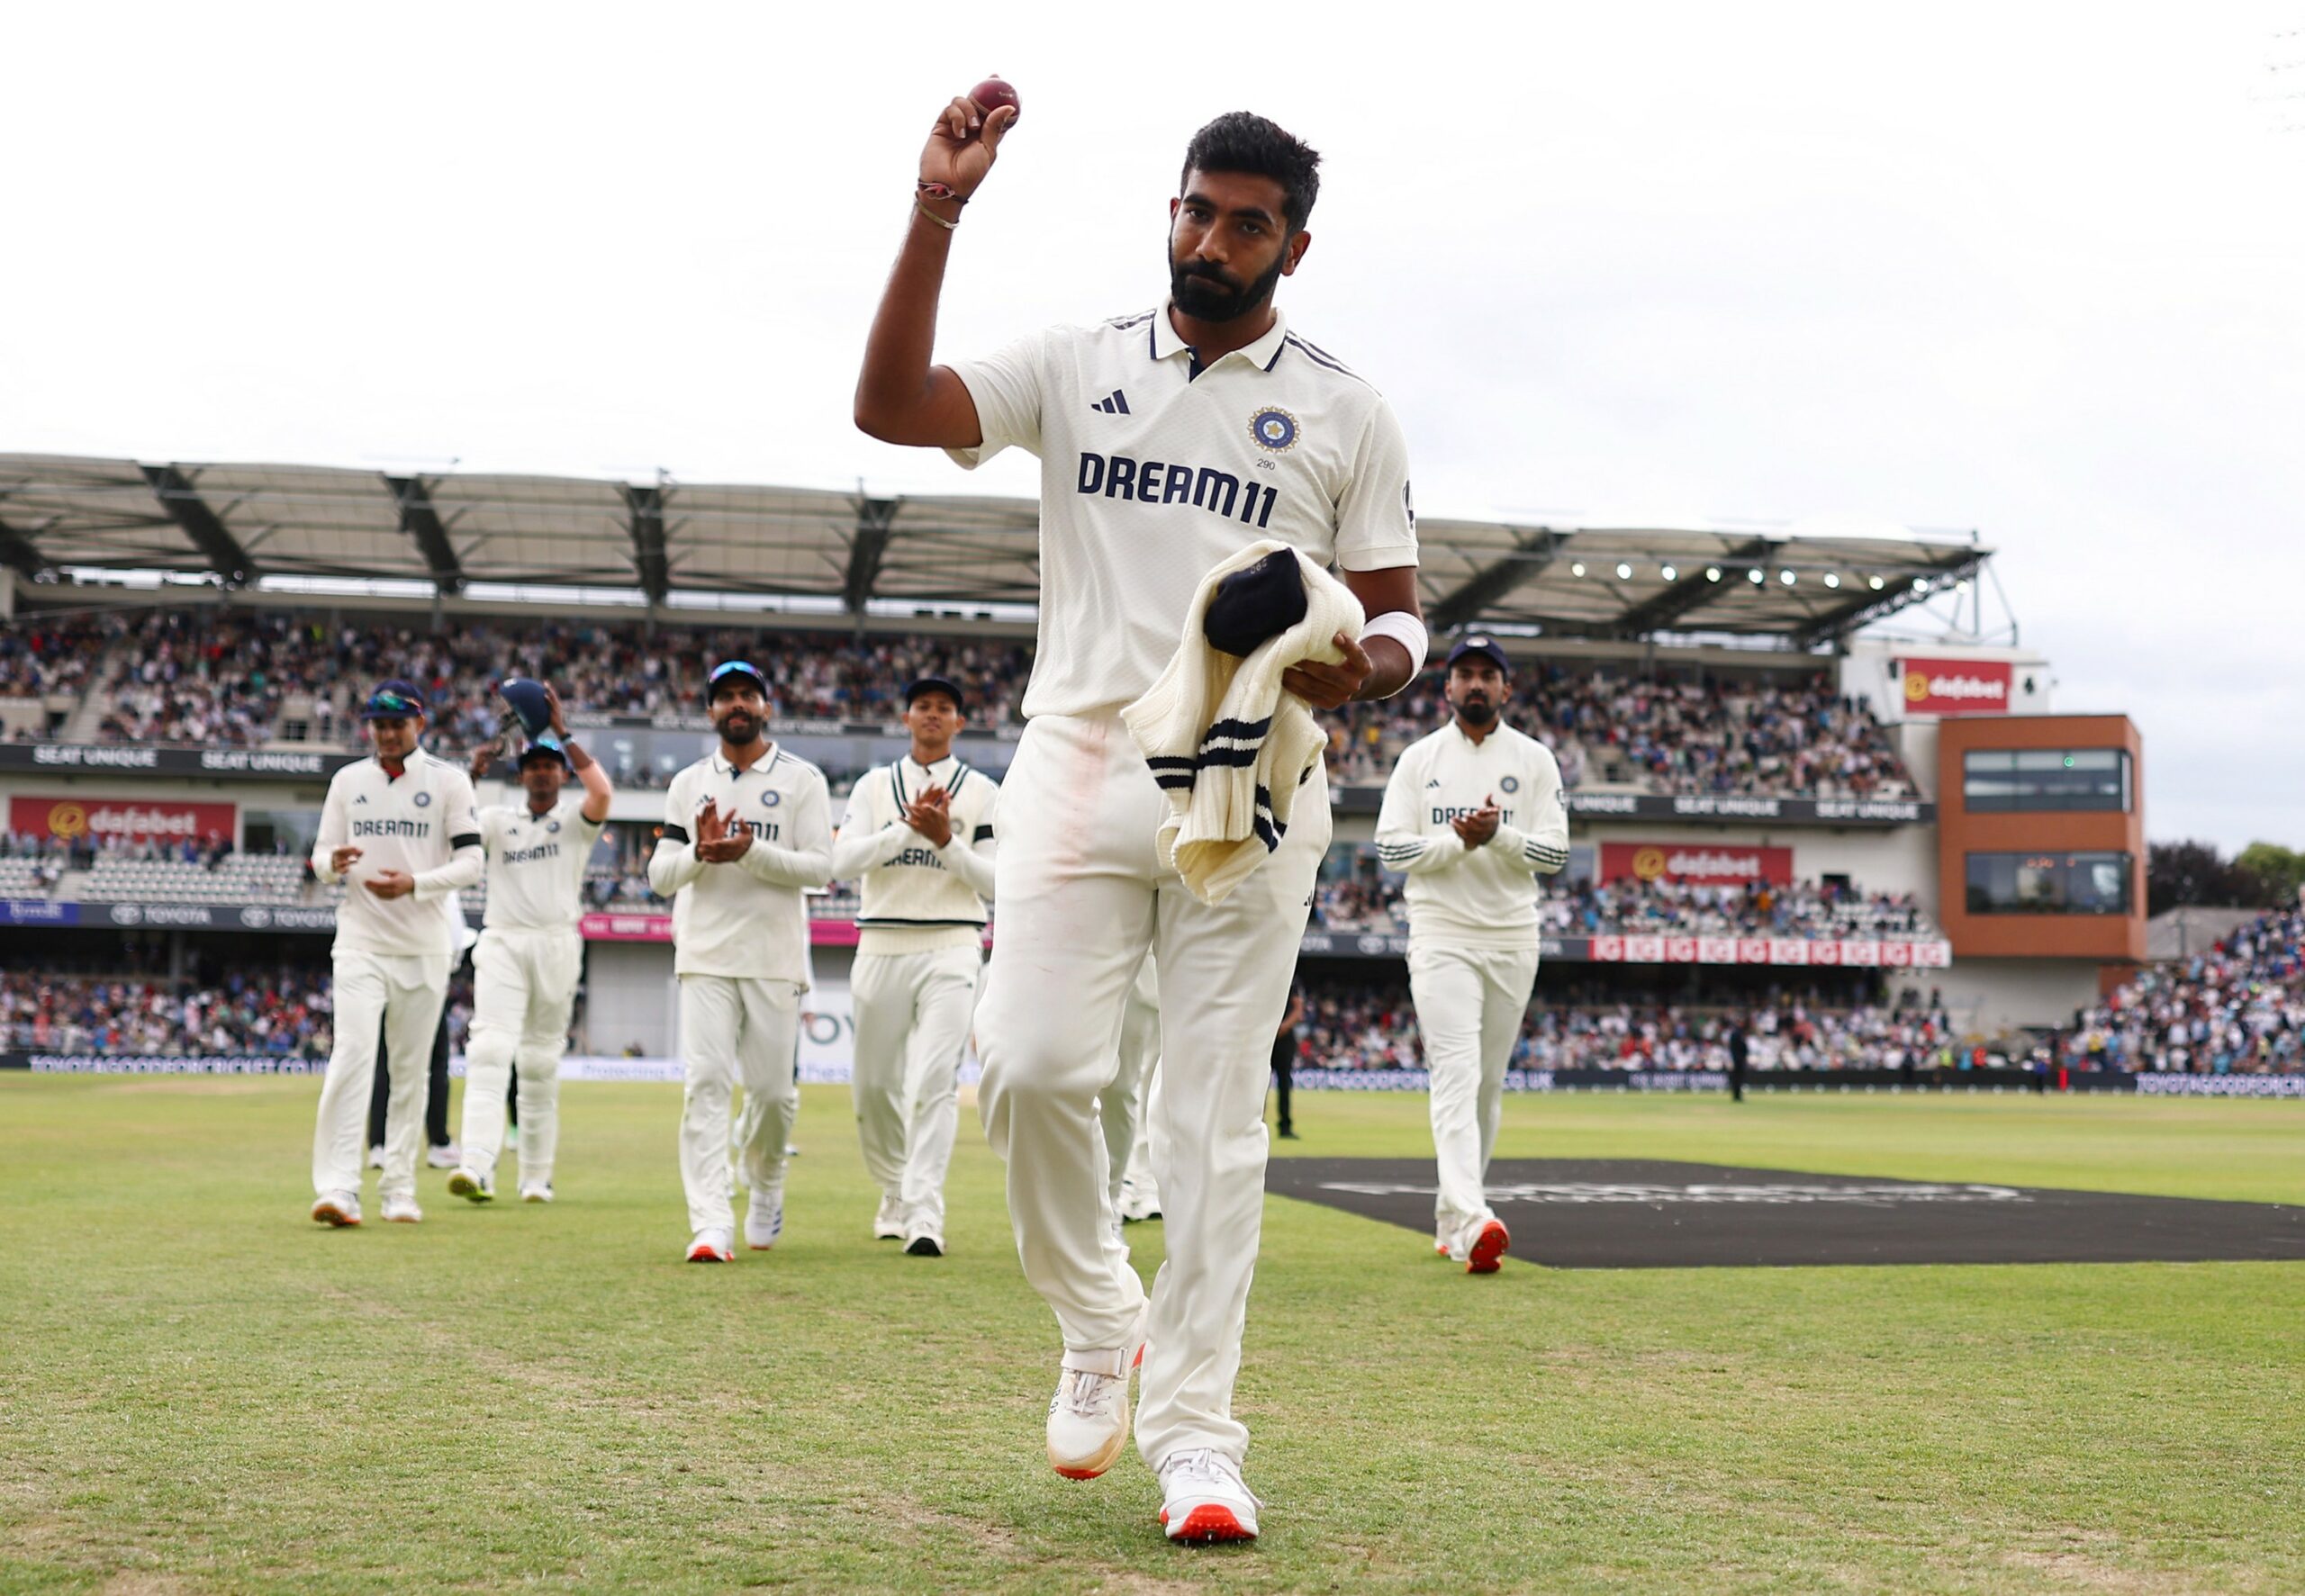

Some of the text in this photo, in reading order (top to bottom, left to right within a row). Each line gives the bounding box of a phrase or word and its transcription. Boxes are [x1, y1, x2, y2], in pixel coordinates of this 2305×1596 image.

[1256, 458, 1276, 470] 290
[1078, 453, 1278, 528] DREAM11
[33, 746, 158, 768] SEAT UNIQUE
[202, 752, 324, 773] SEAT UNIQUE
[88, 807, 197, 836] dafabet
[353, 820, 429, 838] DREAM11
[1666, 851, 1761, 879] dafabet
[144, 906, 212, 924] TOYOTA
